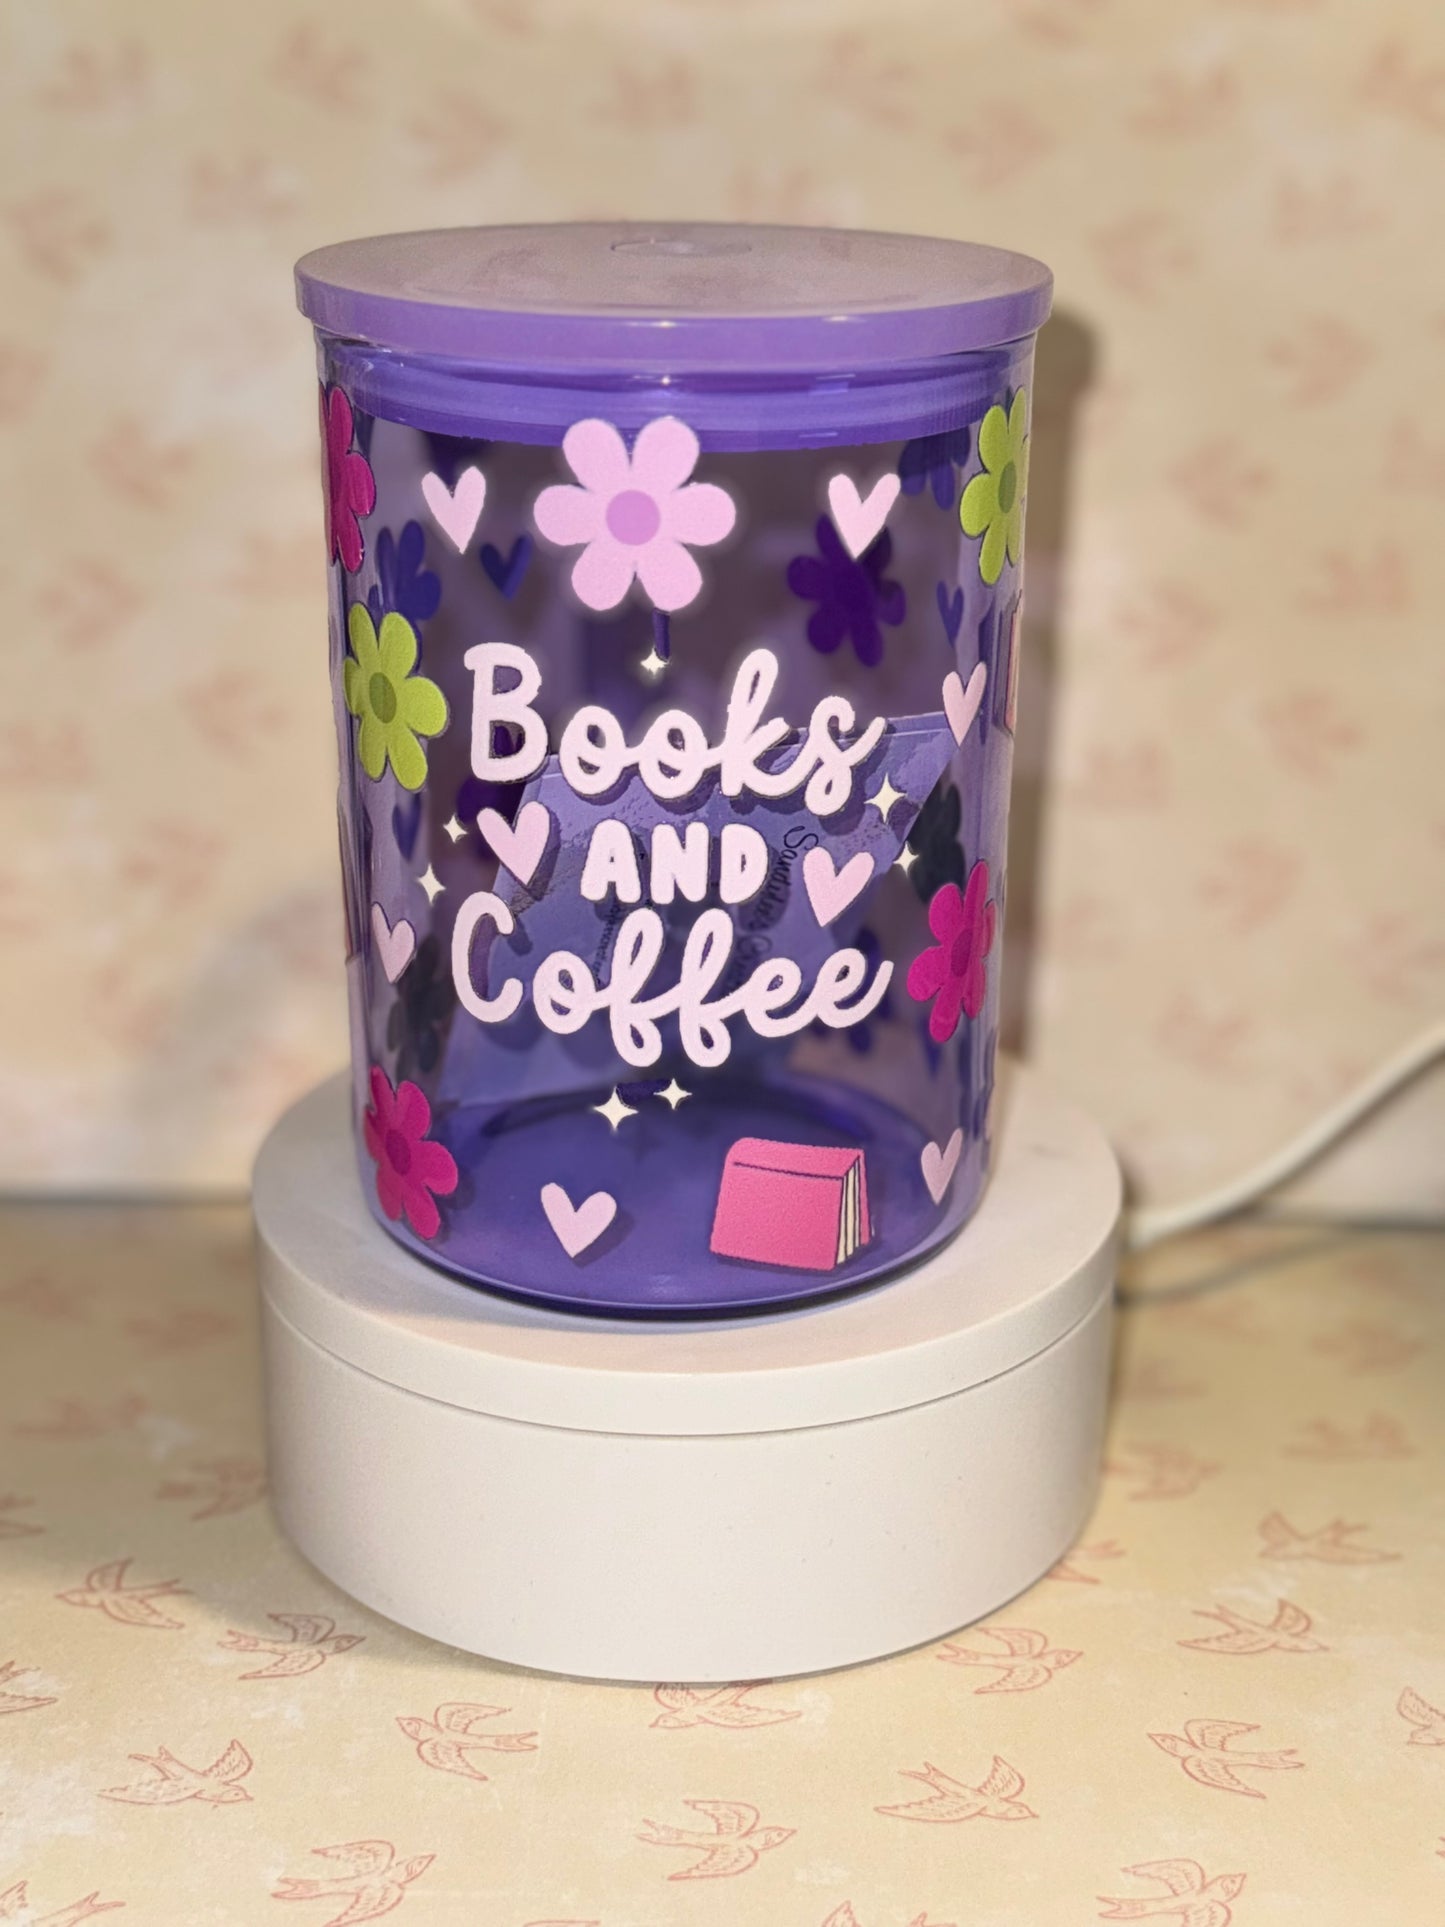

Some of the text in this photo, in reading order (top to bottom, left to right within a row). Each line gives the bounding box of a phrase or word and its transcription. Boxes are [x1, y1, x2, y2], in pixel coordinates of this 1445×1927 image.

[464, 642, 887, 816] Books
[580, 819, 769, 903] AND
[451, 891, 895, 1067] Coffee
